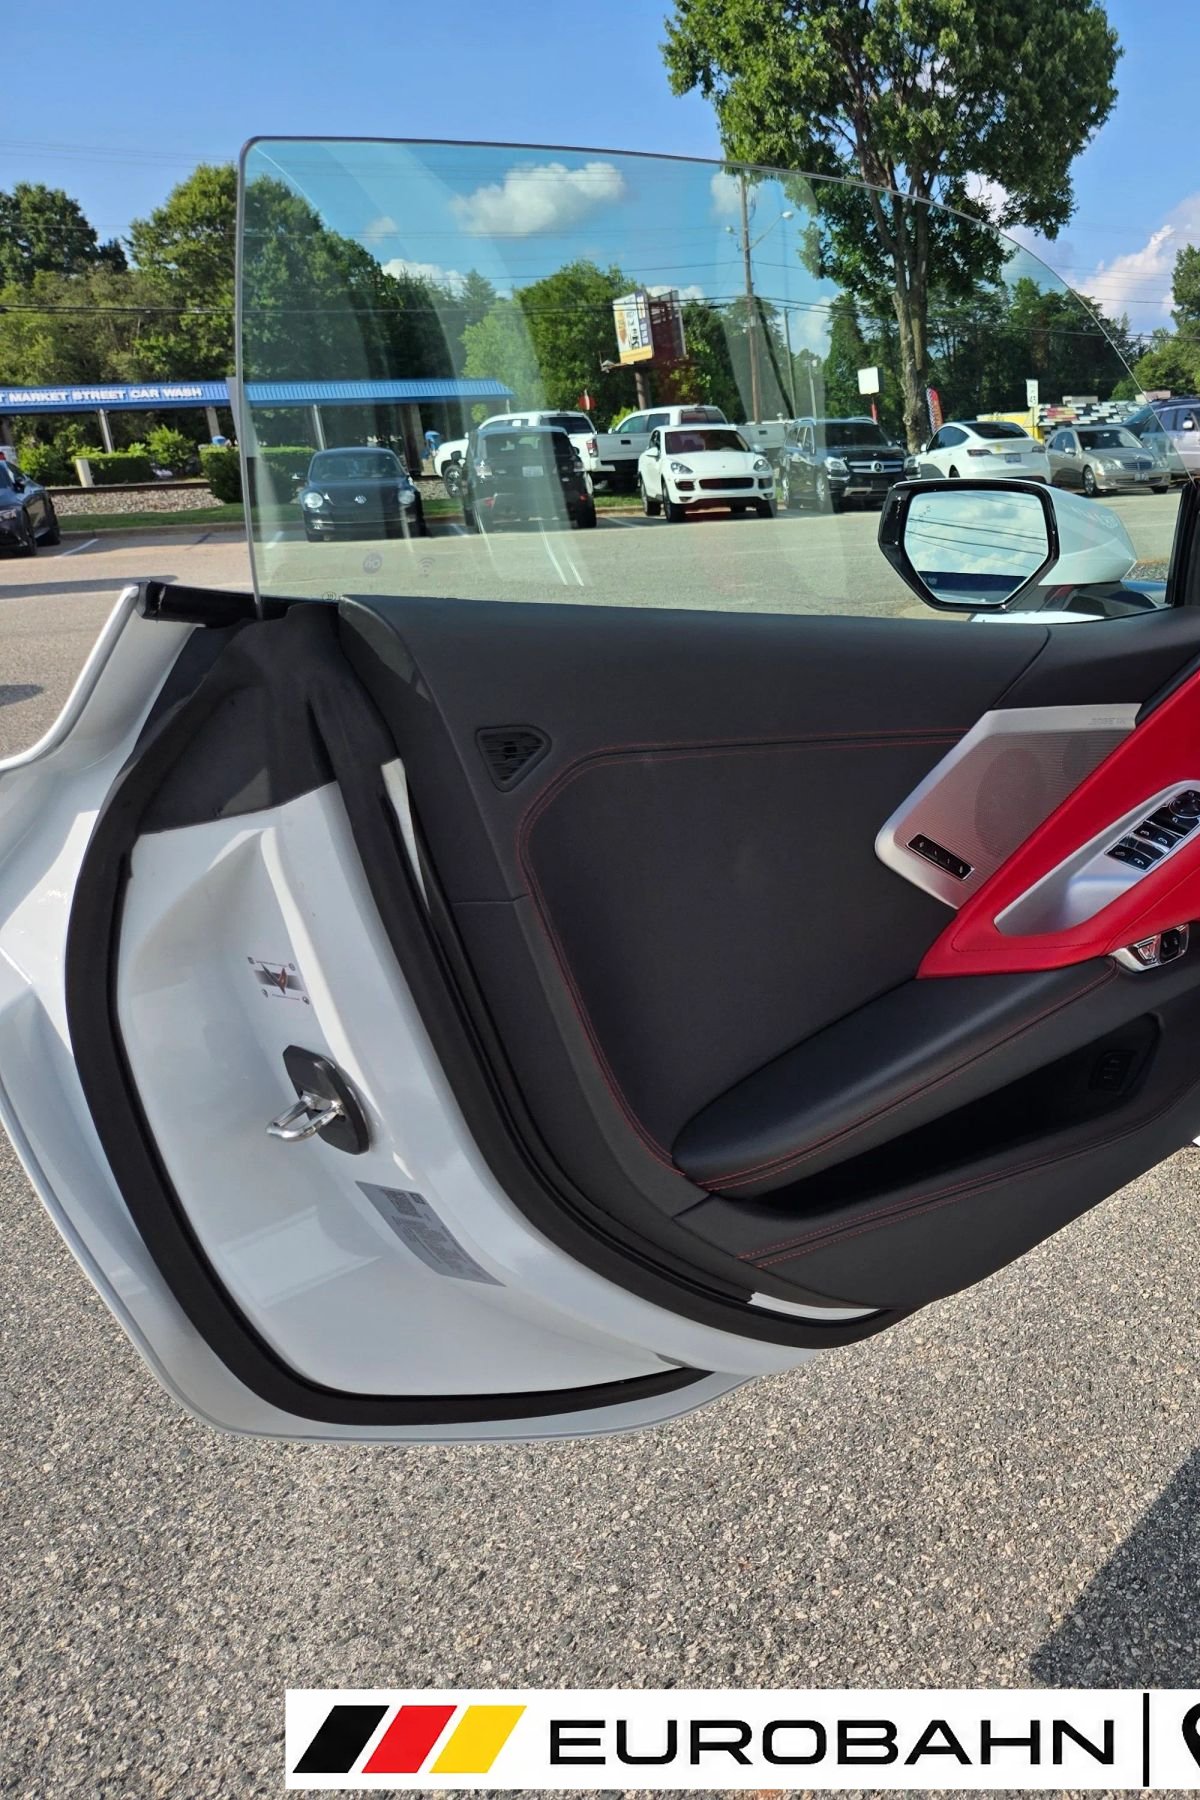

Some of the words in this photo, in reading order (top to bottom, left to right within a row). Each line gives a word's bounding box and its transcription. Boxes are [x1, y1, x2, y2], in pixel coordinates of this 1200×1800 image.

[9, 391, 69, 402] MARKET
[72, 389, 126, 401] STREET
[130, 389, 160, 399] CAR
[162, 387, 202, 398] WASH
